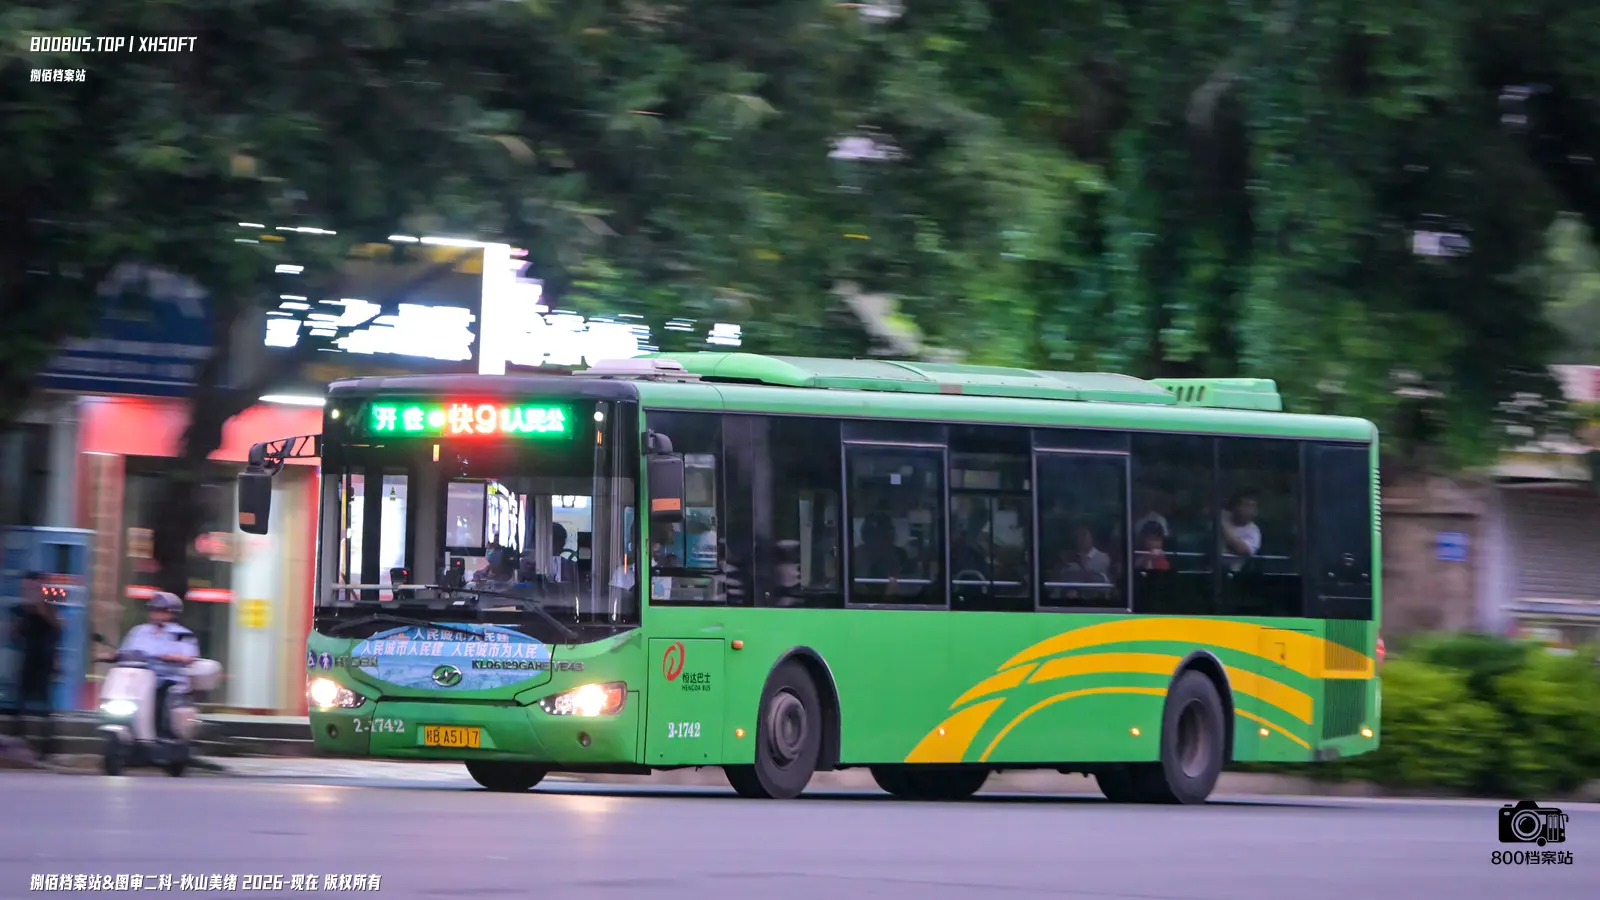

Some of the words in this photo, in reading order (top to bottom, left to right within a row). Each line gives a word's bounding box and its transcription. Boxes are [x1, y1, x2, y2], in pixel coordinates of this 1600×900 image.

[361, 641, 444, 657] 人民城市人民建
[450, 643, 538, 659] 人民城市为人民
[682, 673, 711, 684] 恒达巴士
[353, 718, 405, 733] 2-1742
